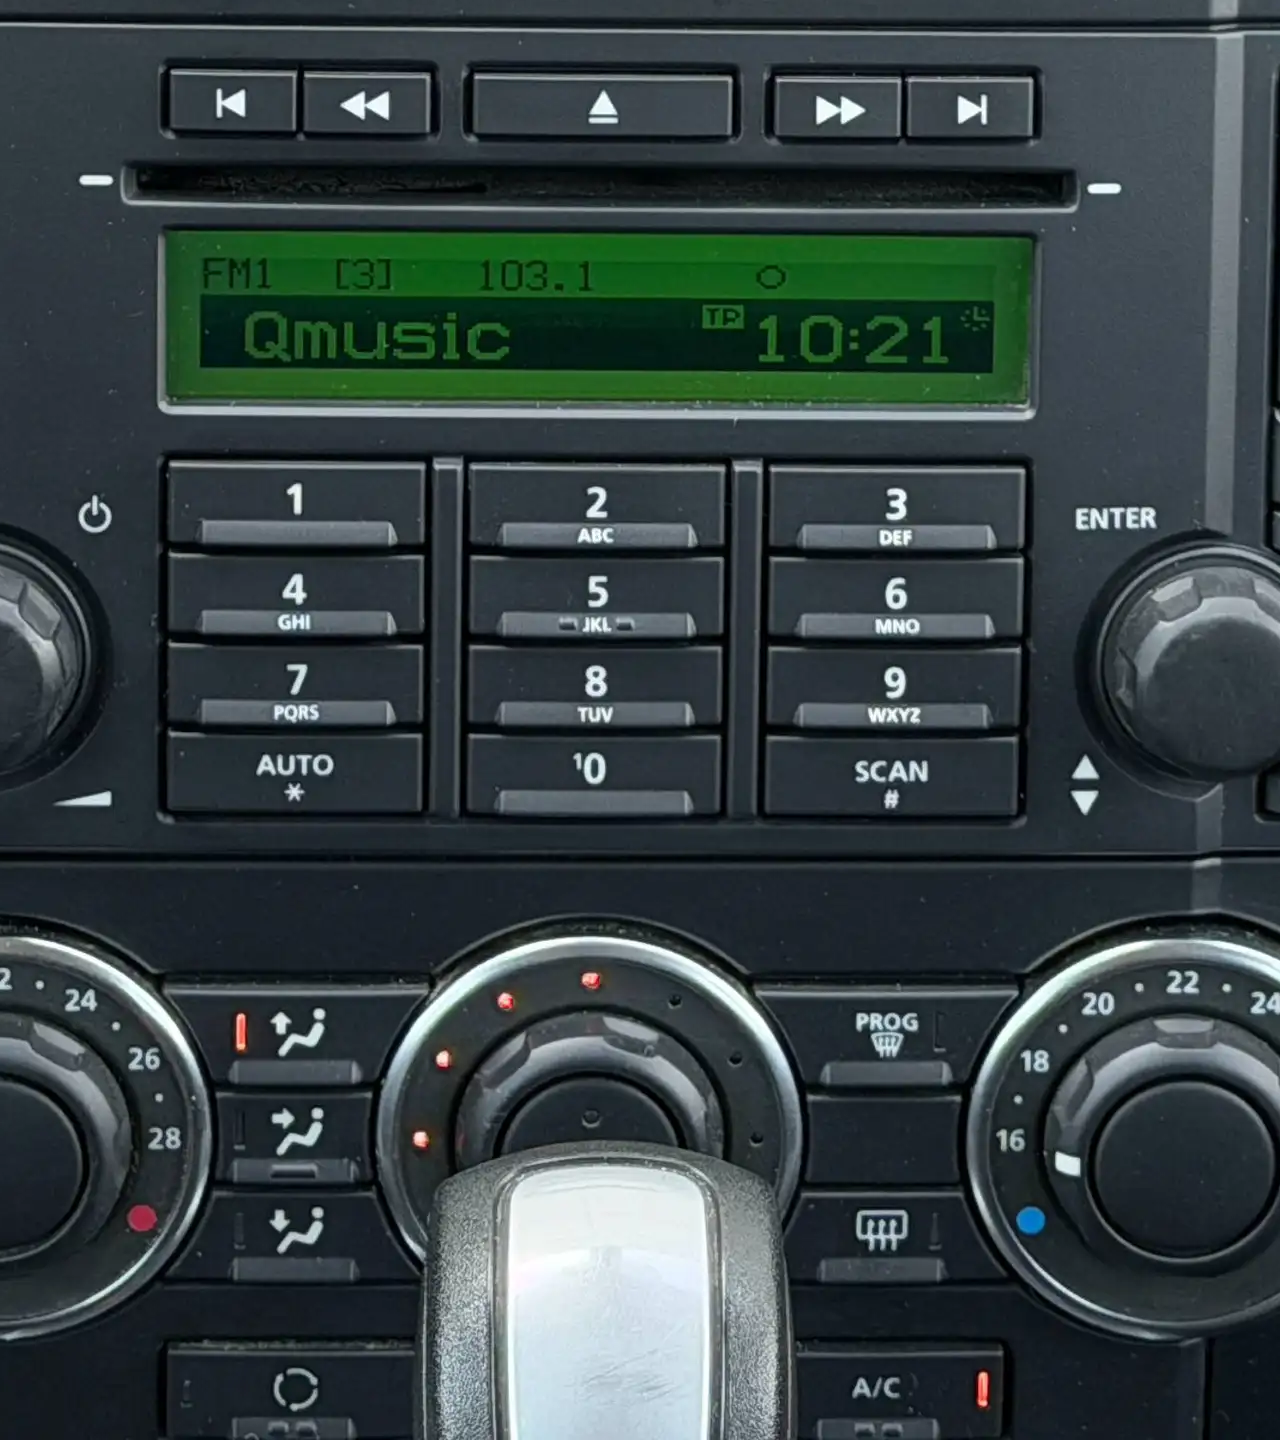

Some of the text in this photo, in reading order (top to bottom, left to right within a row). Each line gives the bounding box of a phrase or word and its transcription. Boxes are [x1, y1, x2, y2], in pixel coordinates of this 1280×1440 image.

[202, 258, 595, 292] FM1 [3] 103.1
[243, 310, 511, 362] Qmusic
[704, 306, 949, 364] TP 10:21
[285, 483, 303, 516] 1
[585, 486, 609, 519] 2
[885, 488, 909, 521] 3
[1074, 507, 1158, 530] ENTER
[577, 527, 614, 544] ABC
[878, 530, 913, 546] DEF
[281, 573, 307, 606] 4
[587, 576, 609, 608] 5
[884, 577, 908, 610] 6
[277, 614, 311, 631] GHI
[582, 617, 612, 633] JKL
[874, 618, 920, 635] MNO
[286, 664, 308, 696] 7
[584, 665, 608, 697] 8
[883, 666, 907, 699] 9
[273, 704, 319, 722] PQRS
[577, 707, 614, 724] TUV
[868, 707, 921, 724] WXYZ
[256, 754, 334, 777] AUTO
[854, 760, 929, 783] SCAN
[1165, 970, 1200, 995] 22
[64, 989, 98, 1012] 24
[1081, 991, 1115, 1016] 20
[856, 1013, 919, 1032] PROG
[127, 1047, 161, 1071] 26
[1021, 1050, 1050, 1073] 18
[147, 1127, 182, 1150] 28
[996, 1128, 1026, 1152] 16
[851, 1375, 902, 1400] A/C
